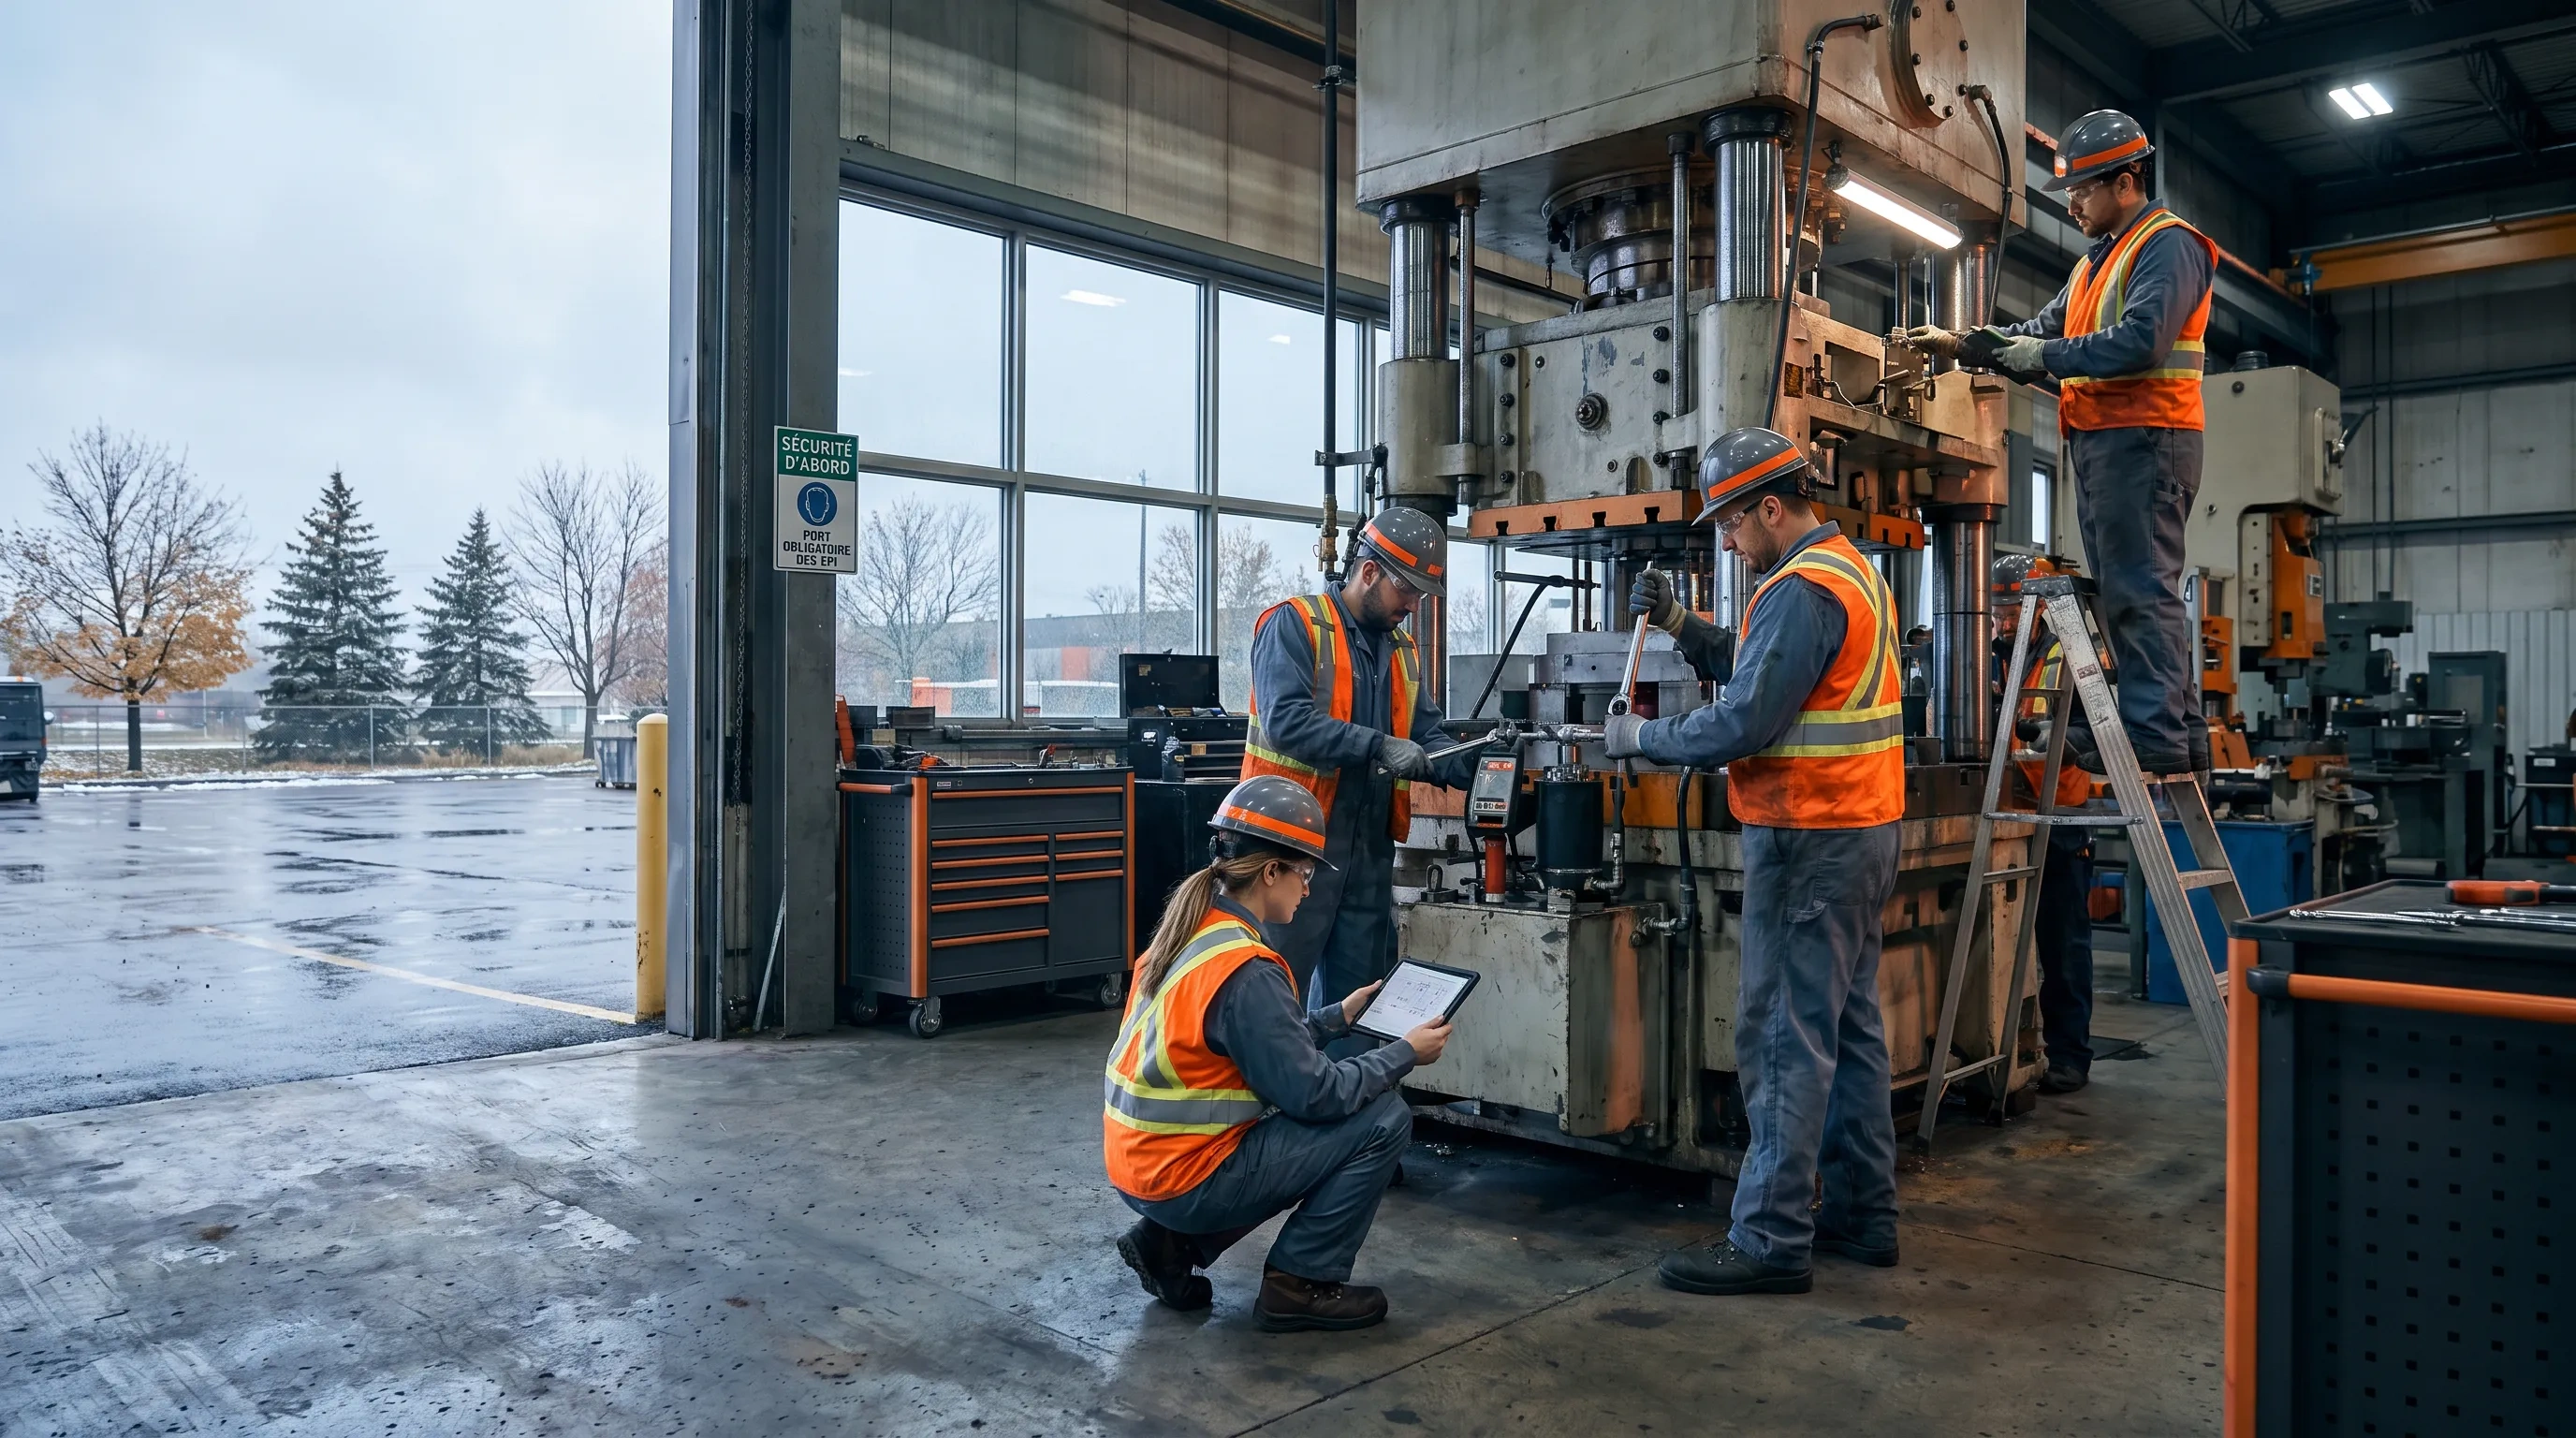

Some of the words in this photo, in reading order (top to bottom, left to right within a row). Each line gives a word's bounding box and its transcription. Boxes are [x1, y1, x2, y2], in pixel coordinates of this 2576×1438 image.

[782, 433, 853, 458] SÉCURITÉ
[785, 455, 850, 476] D'ABORD
[803, 530, 831, 542] PORT
[783, 540, 851, 556] OBLIGATOIRE
[796, 554, 817, 566] DES
[820, 555, 838, 567] EPI
